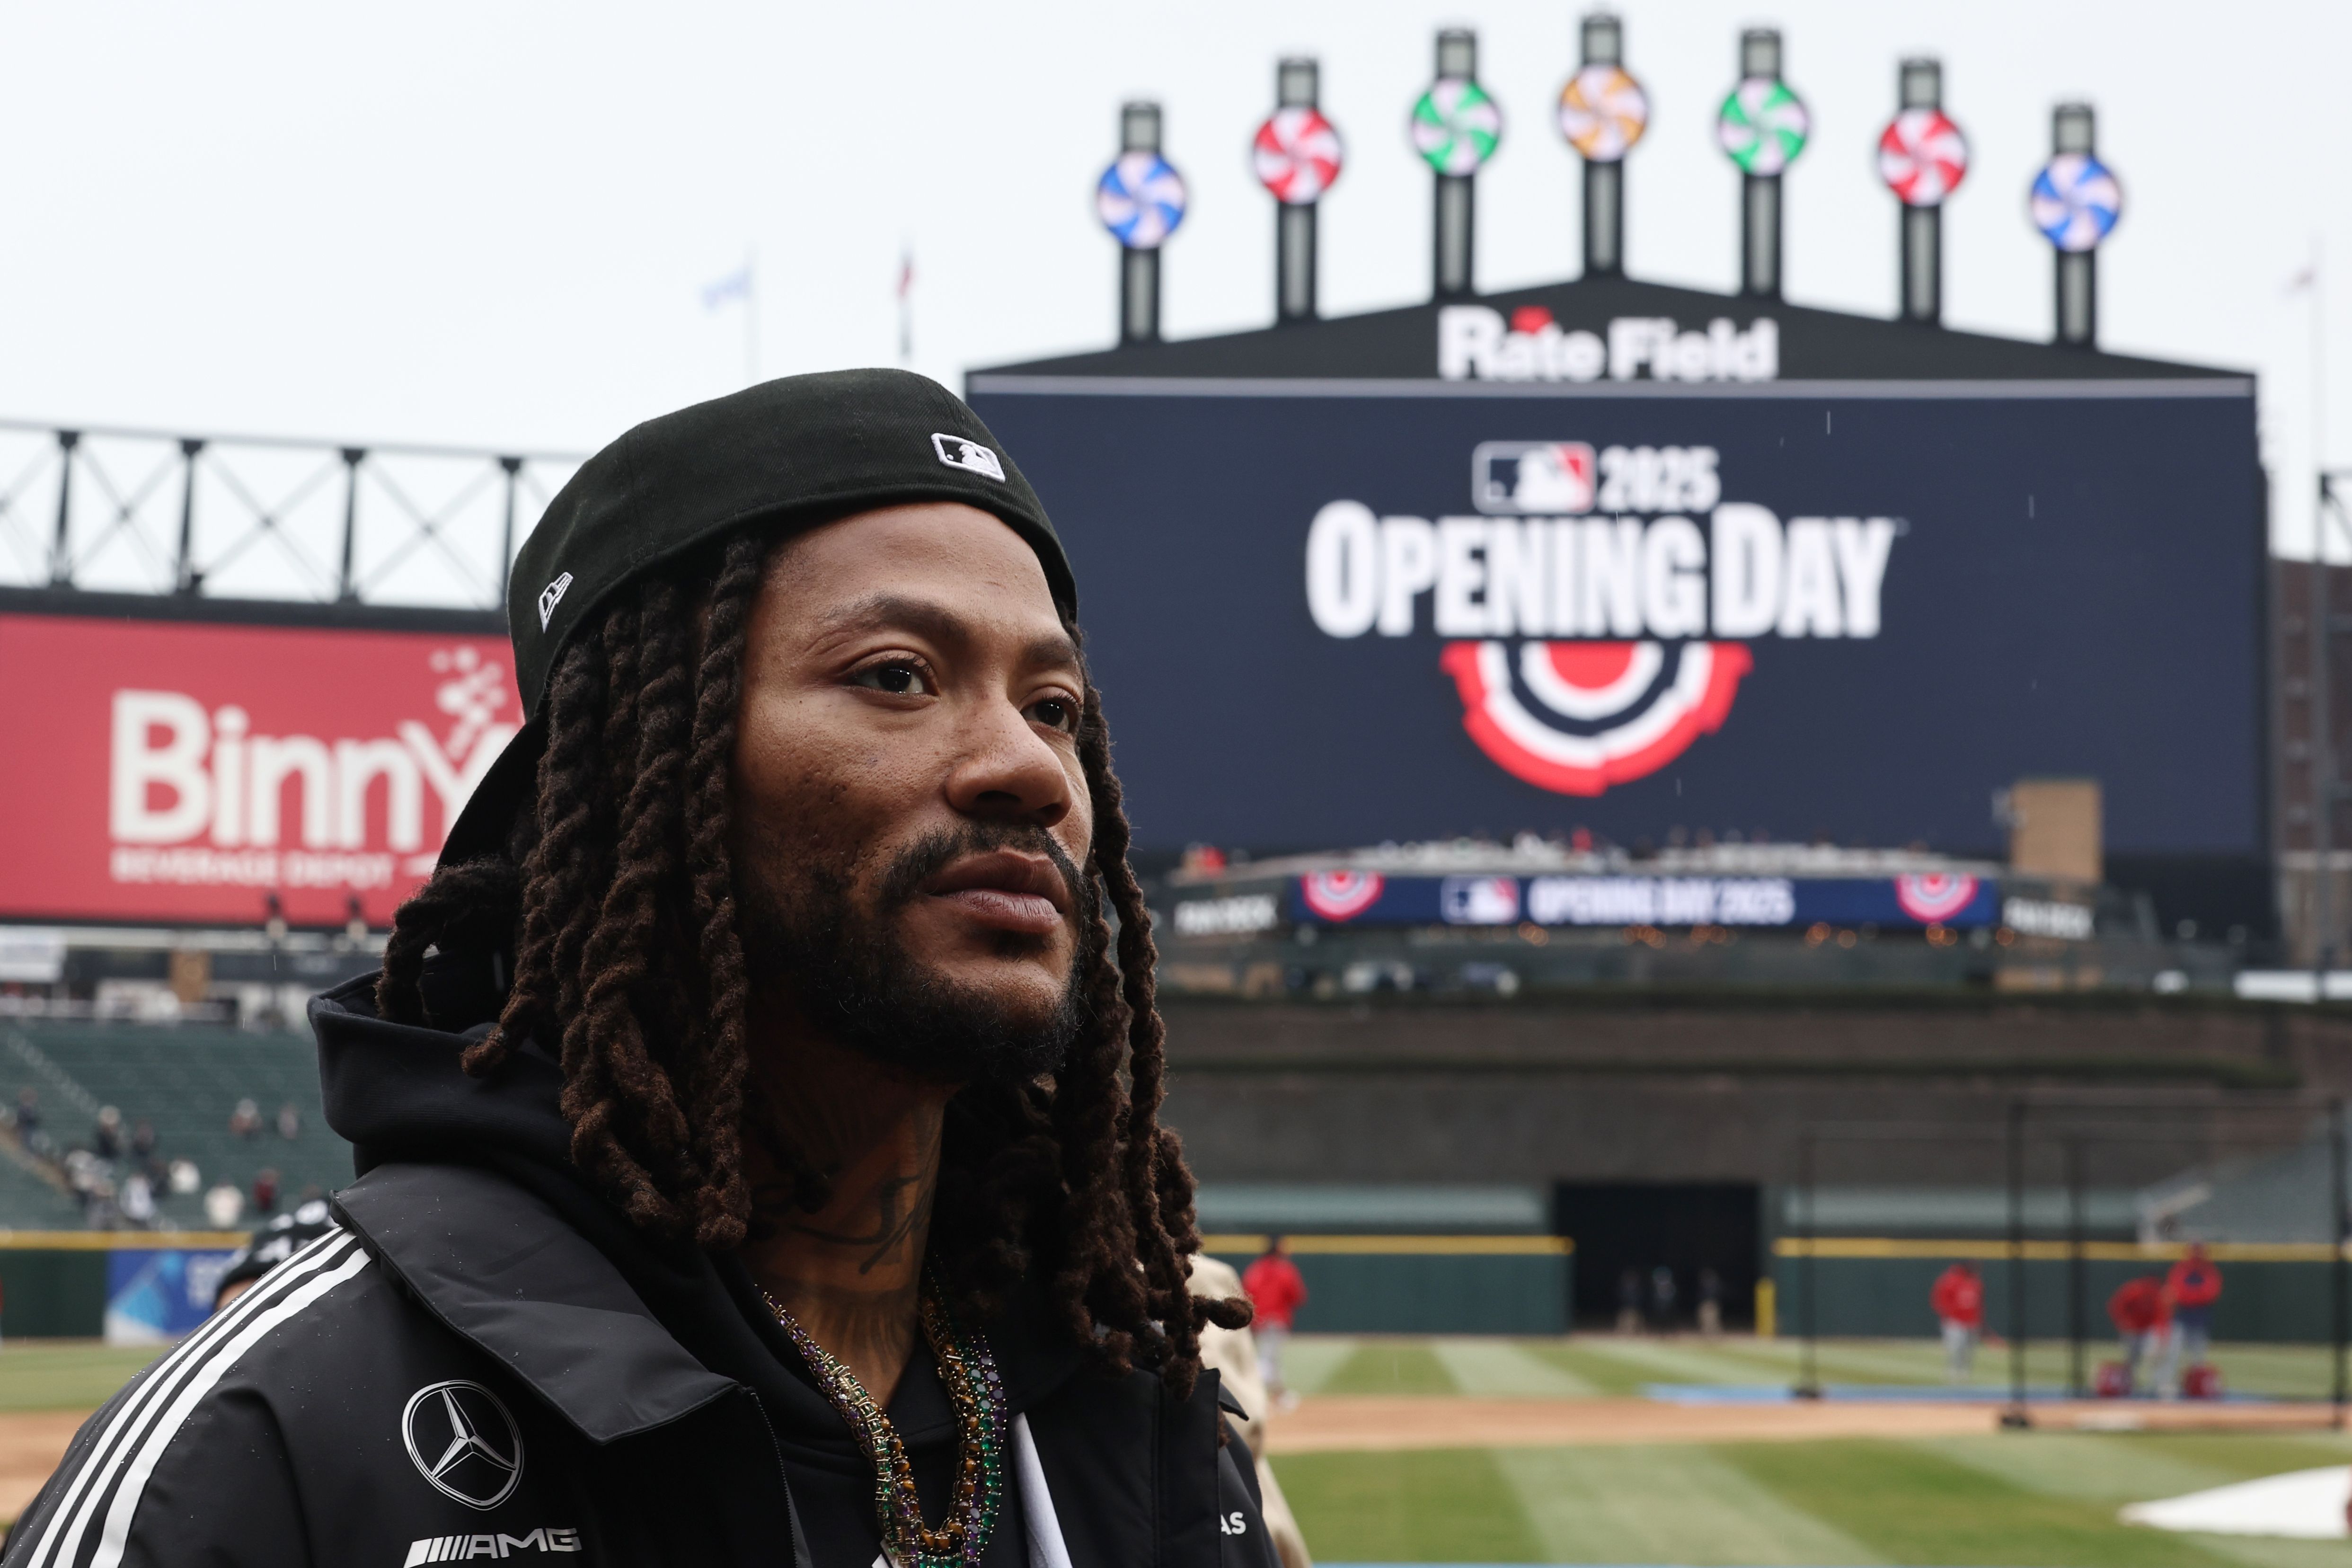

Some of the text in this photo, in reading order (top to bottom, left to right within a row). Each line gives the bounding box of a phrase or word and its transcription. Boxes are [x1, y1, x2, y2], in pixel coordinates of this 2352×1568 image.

[1438, 304, 1779, 381] Rate Field
[1600, 446, 1722, 511] 2025
[1305, 500, 1893, 638] OPENING DAY
[466, 1528, 582, 1559] AMG
